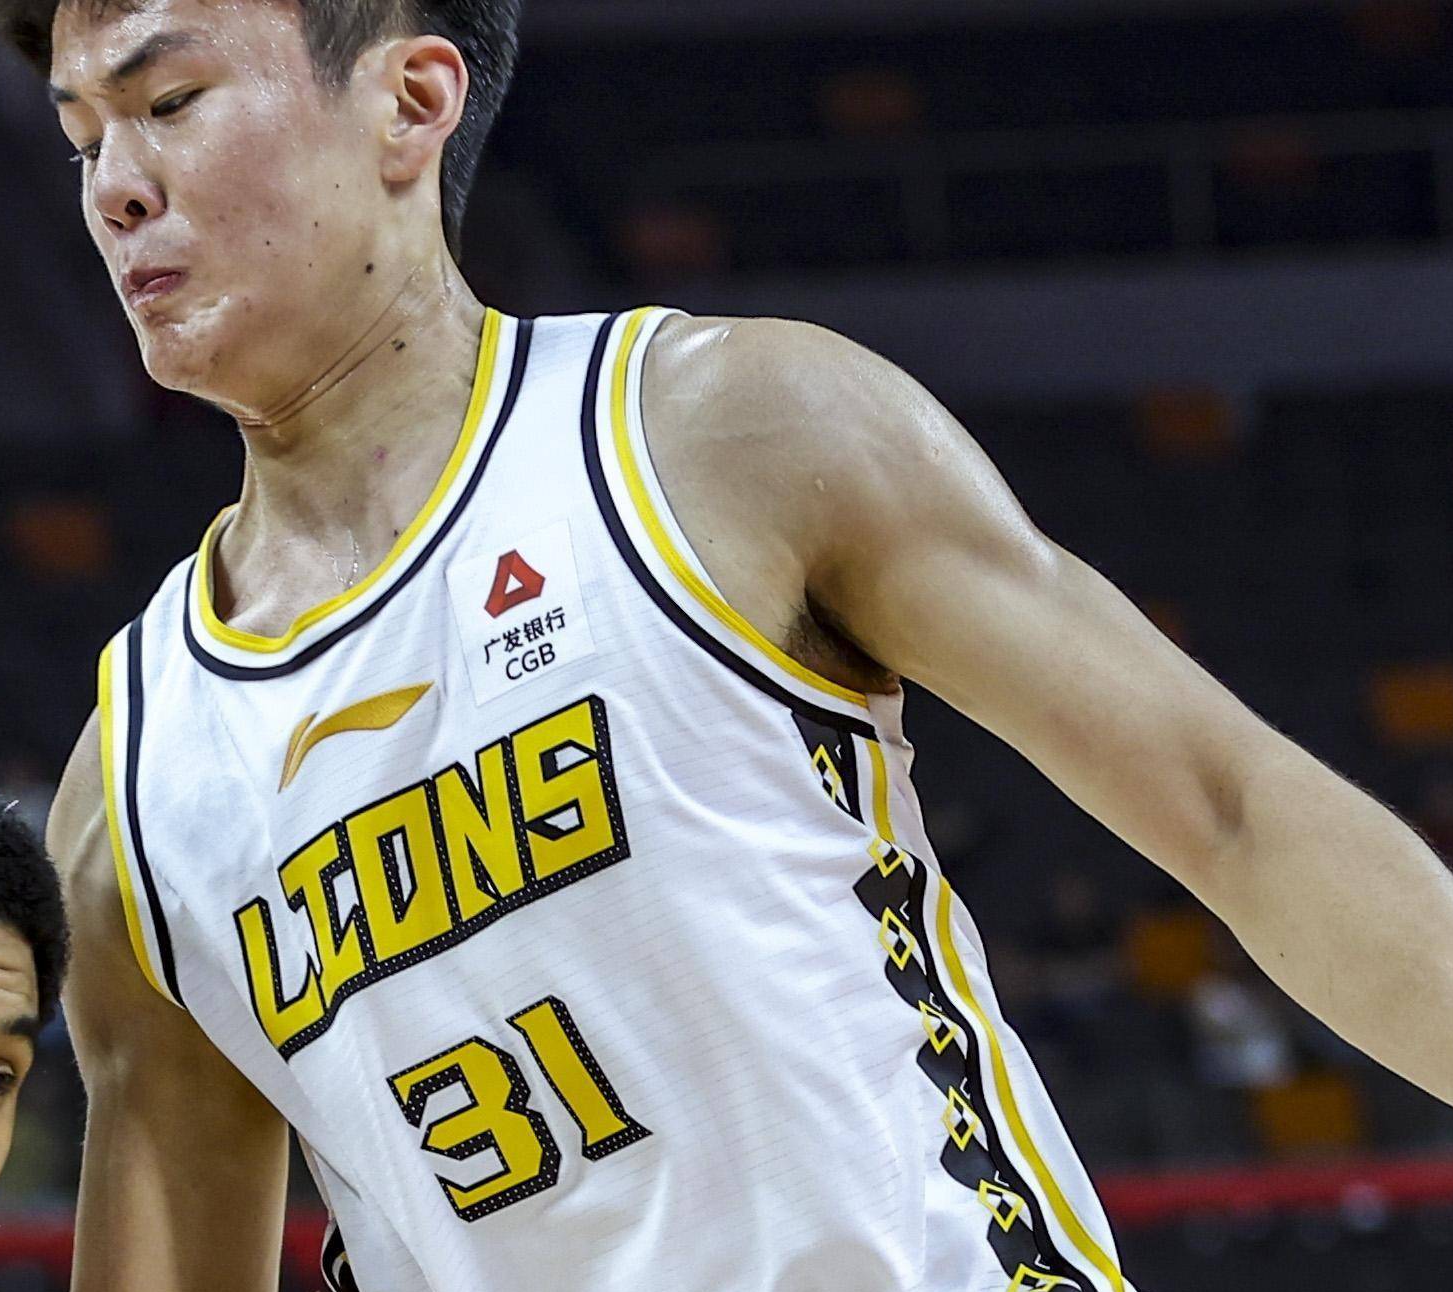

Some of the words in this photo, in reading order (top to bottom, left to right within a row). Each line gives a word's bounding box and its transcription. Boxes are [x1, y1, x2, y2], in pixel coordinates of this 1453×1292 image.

[484, 606, 566, 664] 广发银行
[505, 642, 556, 680] CGB
[233, 693, 631, 1061] LIONS
[386, 995, 654, 1223] 31
